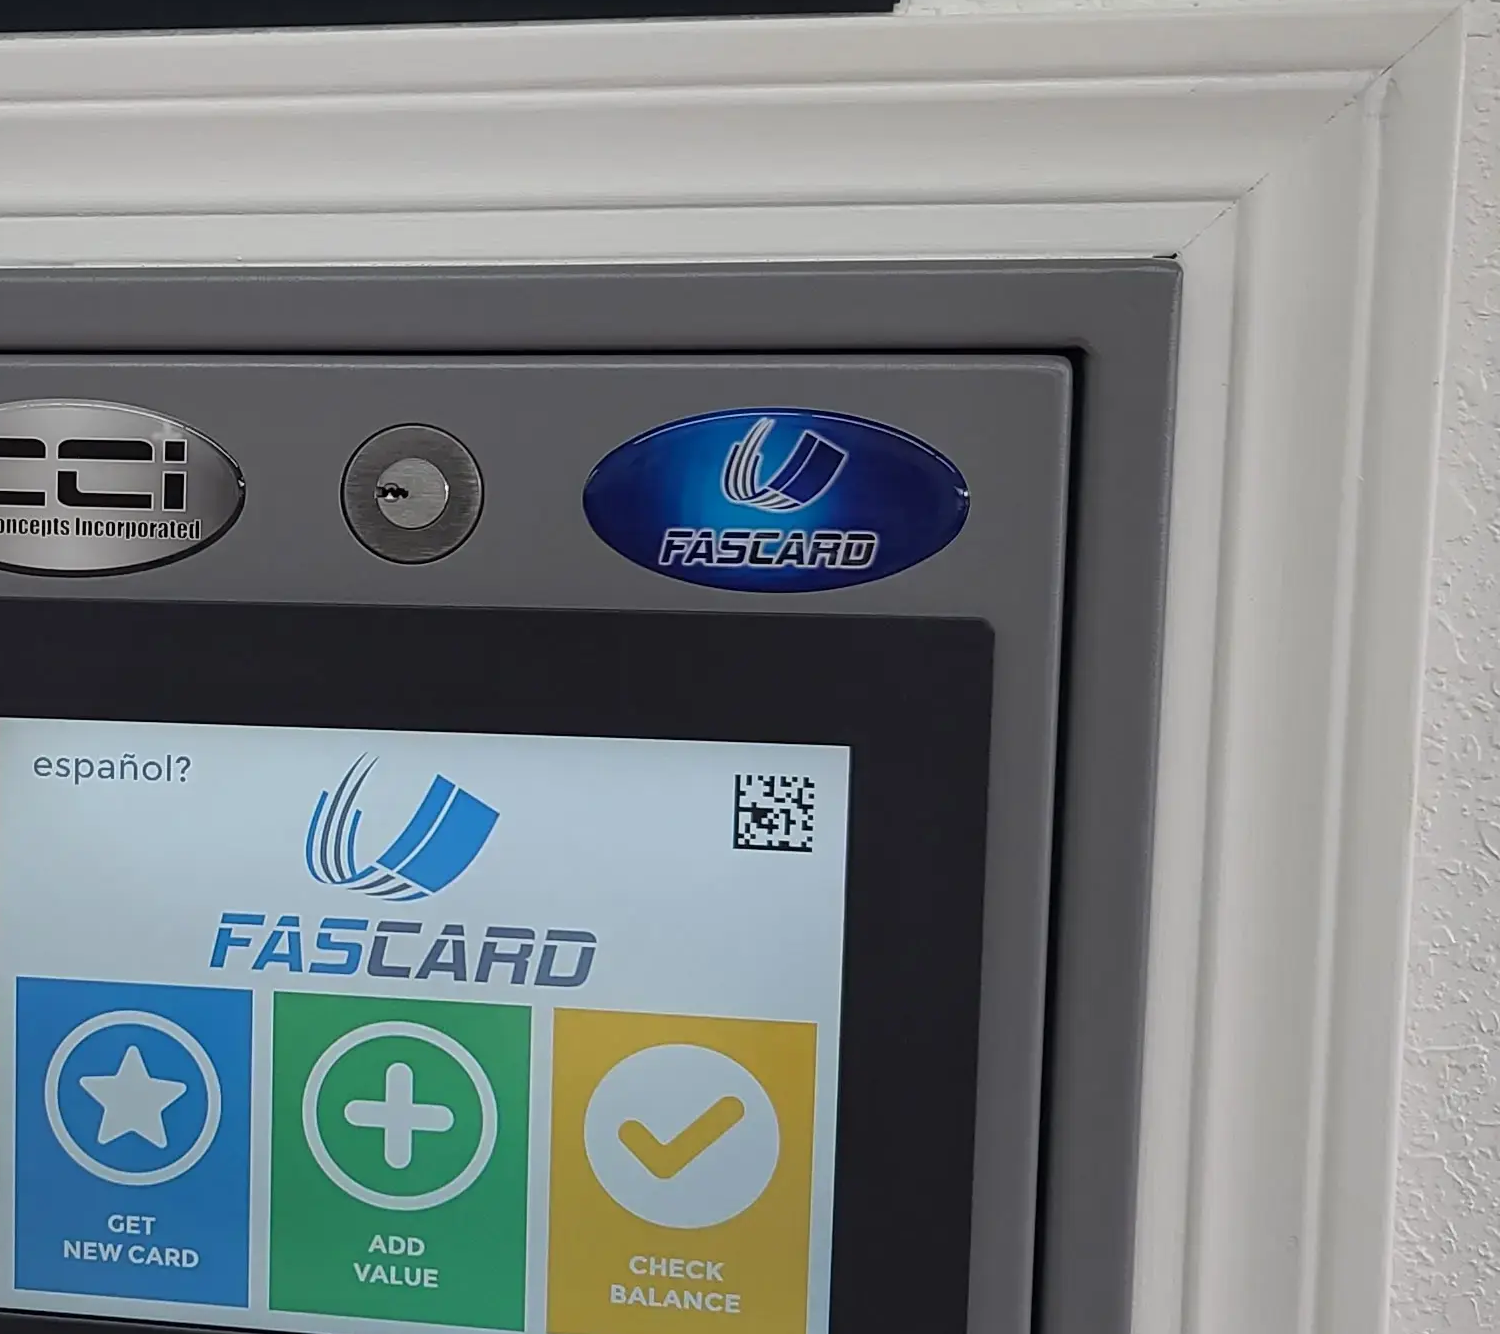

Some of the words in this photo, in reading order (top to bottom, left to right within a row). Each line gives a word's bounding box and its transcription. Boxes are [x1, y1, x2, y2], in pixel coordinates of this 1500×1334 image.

[75, 517, 202, 540] Incorporated
[659, 527, 880, 569] FASCARD
[32, 752, 193, 787] español?
[208, 911, 599, 988] FASCARD
[106, 1213, 157, 1237] GET
[62, 1239, 124, 1263] NEW
[128, 1244, 200, 1269] CARD
[367, 1234, 426, 1257] ADD
[352, 1262, 440, 1288] VALUE
[627, 1255, 725, 1282] CHECK
[609, 1283, 742, 1314] BALANCE
